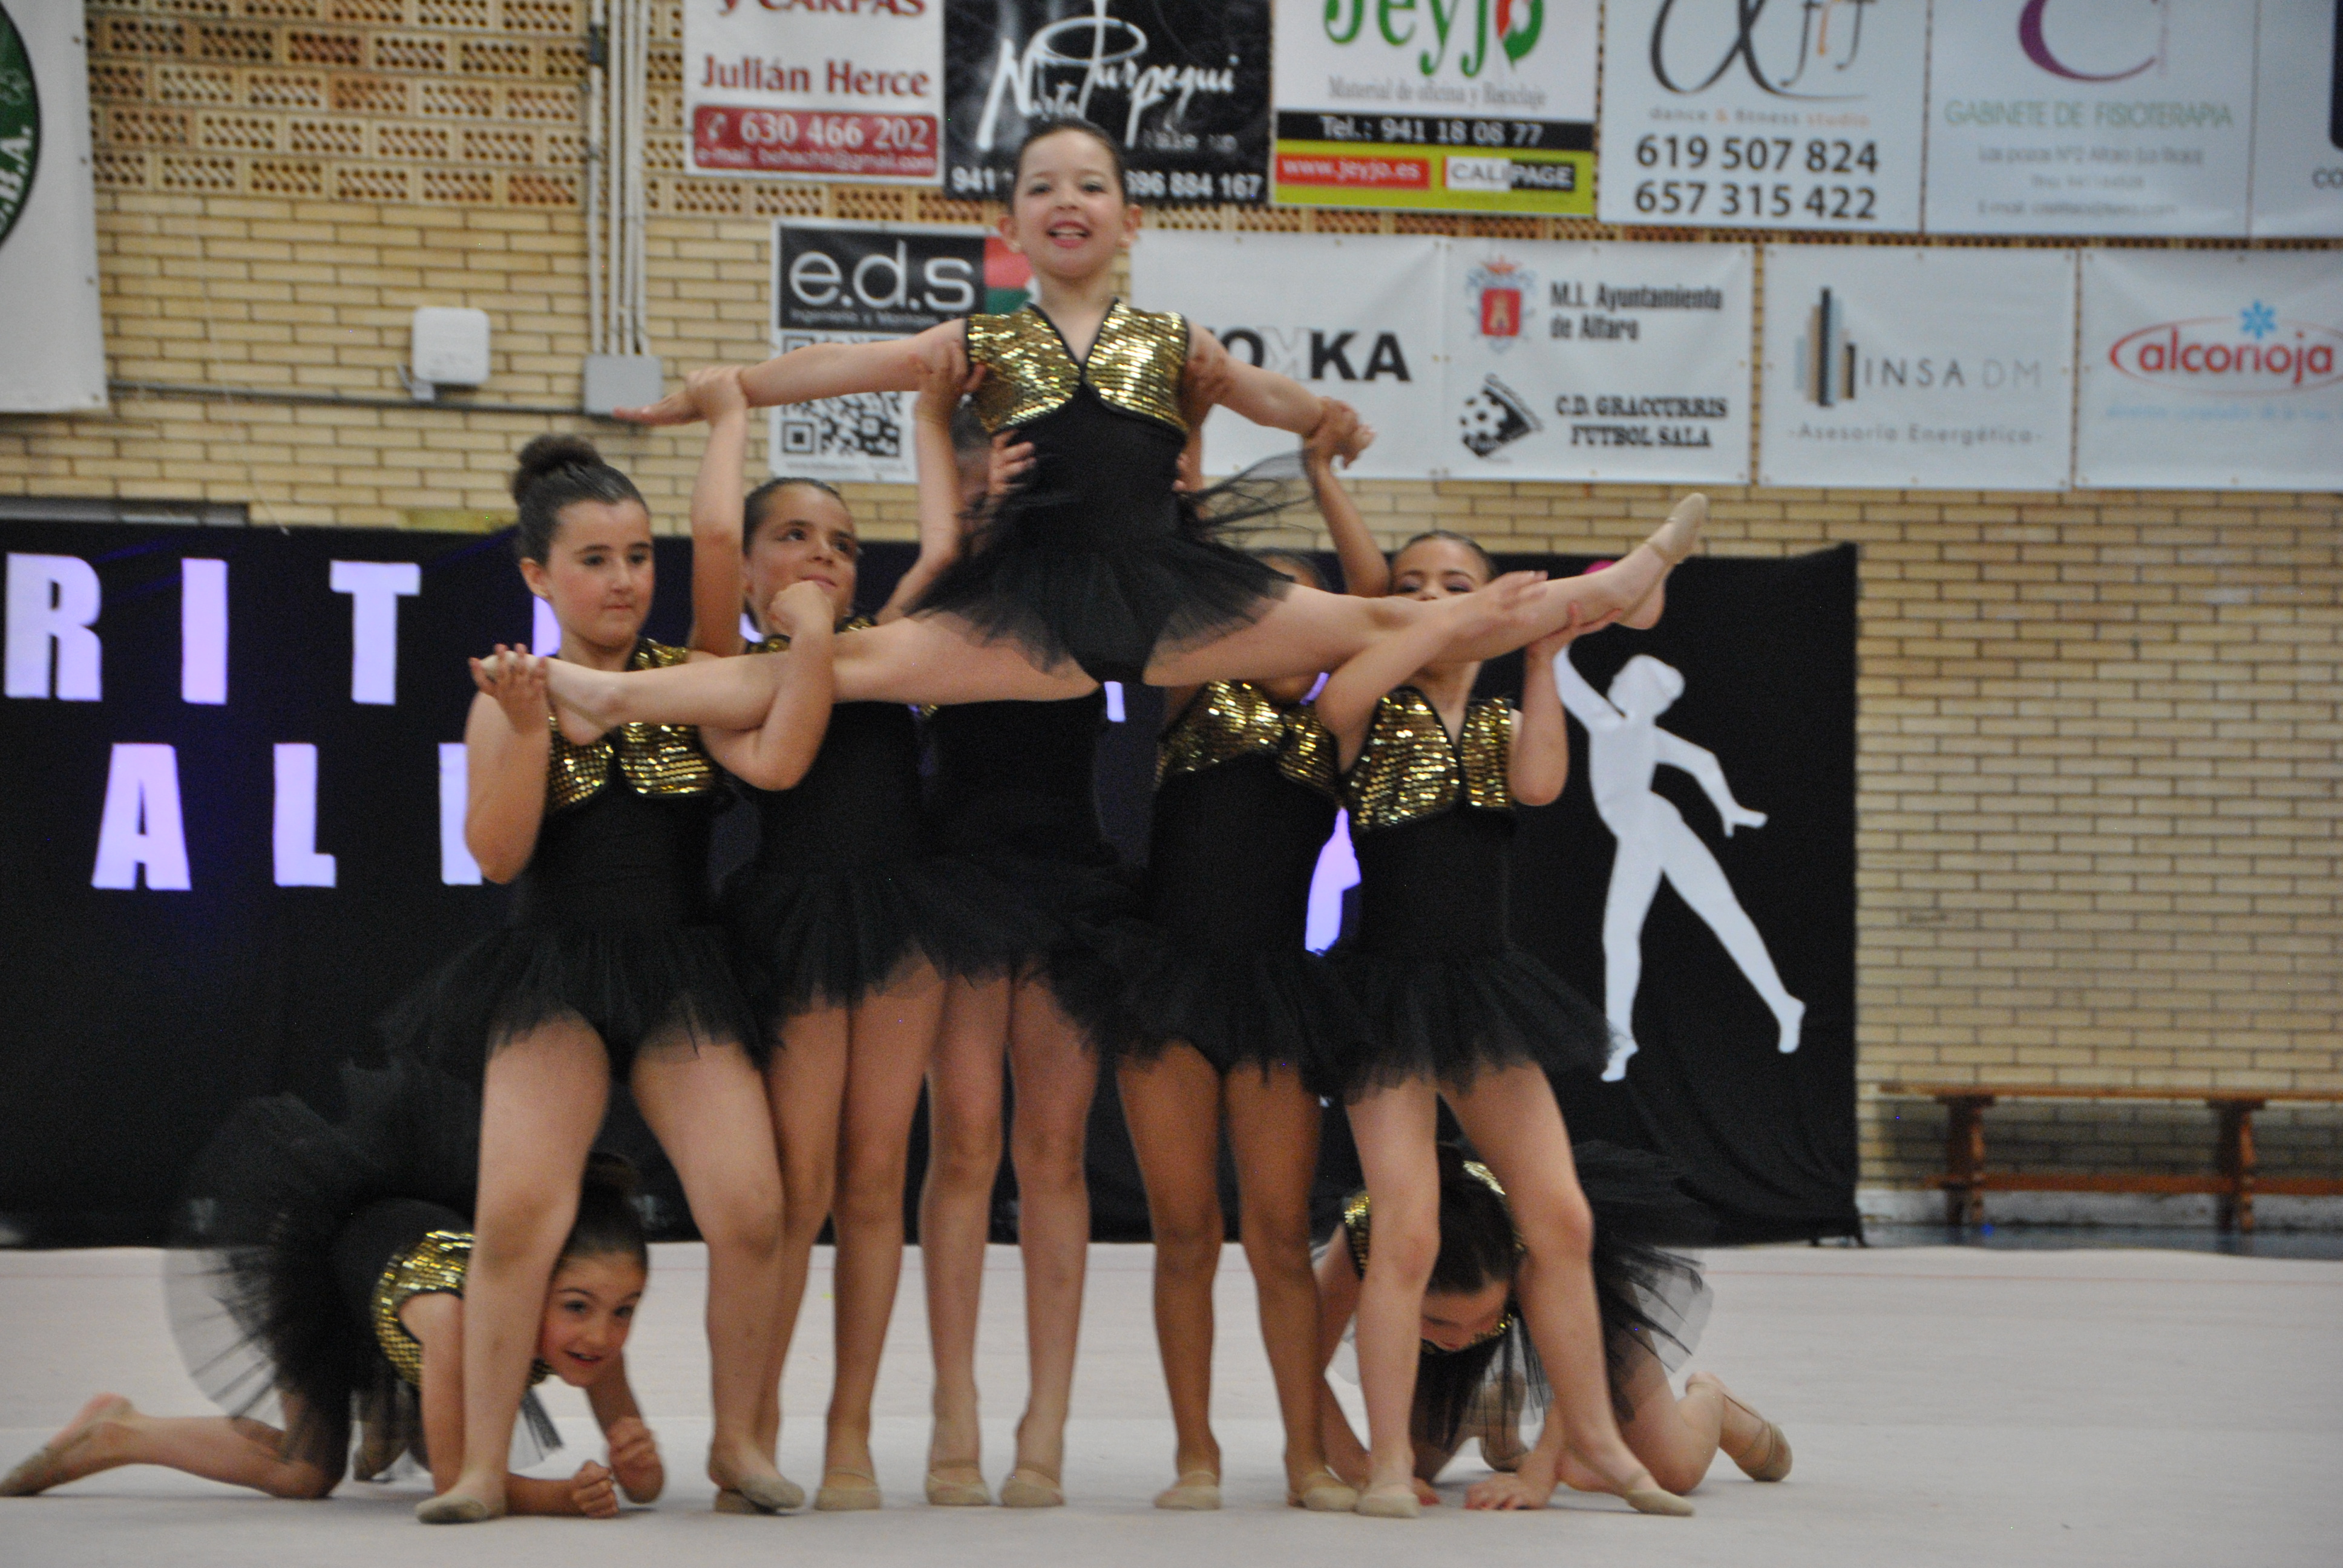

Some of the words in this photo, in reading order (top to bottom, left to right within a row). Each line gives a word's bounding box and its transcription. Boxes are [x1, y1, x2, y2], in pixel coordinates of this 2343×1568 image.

[701, 54, 811, 93] Julián
[827, 59, 929, 97] Herce
[2054, 100, 2085, 128] DE
[739, 112, 799, 144] 630
[805, 116, 864, 148] 466
[873, 118, 929, 152] 202
[1380, 117, 1426, 143] 941
[1514, 123, 1544, 148] 77
[1636, 134, 1709, 169] 619
[1722, 137, 1794, 171] 507
[1806, 139, 1878, 174] 824
[951, 166, 996, 192] 941
[1281, 158, 1422, 181] www.jeyjo.es
[1220, 173, 1262, 200] 167
[1635, 181, 1706, 214] 657
[1720, 184, 1791, 217] 315
[1804, 186, 1876, 220] 422
[789, 240, 975, 312] e.d.s
[1595, 282, 1723, 312] Ayuntamiento
[1550, 313, 1571, 339] de
[1579, 313, 1639, 340] Alfaro
[1863, 359, 1967, 387] INSA
[1658, 426, 1712, 448] SALA
